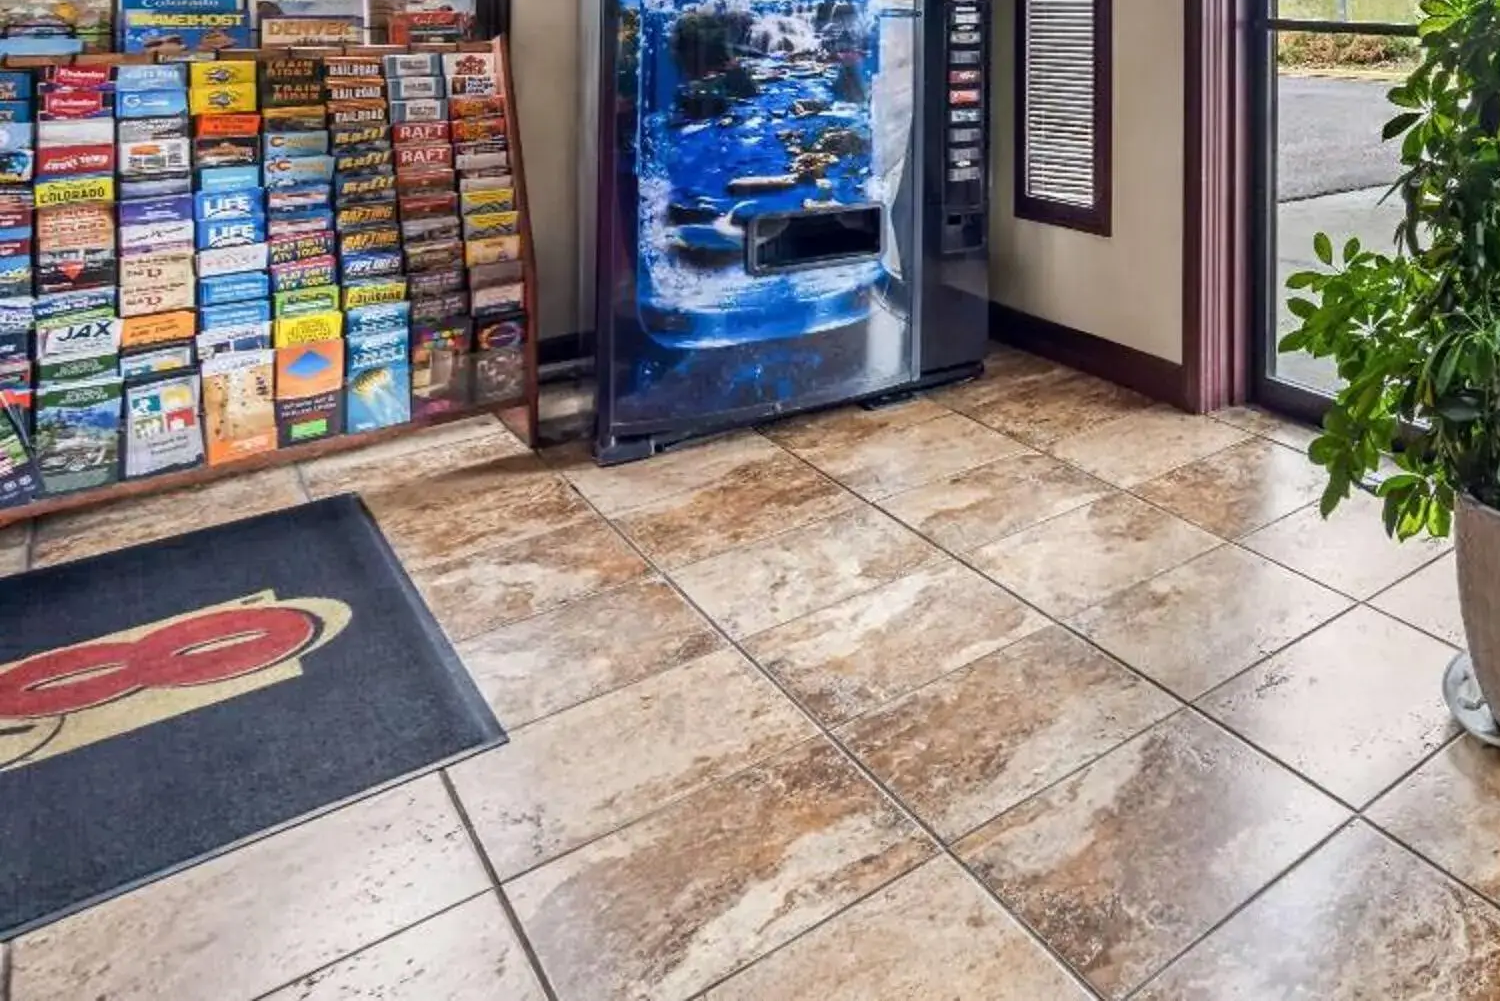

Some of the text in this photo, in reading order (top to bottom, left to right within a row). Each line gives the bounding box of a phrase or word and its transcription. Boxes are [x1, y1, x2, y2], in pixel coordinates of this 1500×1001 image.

[329, 63, 380, 76] RAILROAD
[331, 86, 381, 99] RAILROAD
[400, 124, 446, 139] RAFT
[401, 148, 447, 162] RAFT
[39, 186, 105, 203] COLORADO
[203, 195, 252, 218] LIFE
[208, 223, 256, 247] LIFE
[56, 320, 112, 341] JAX
